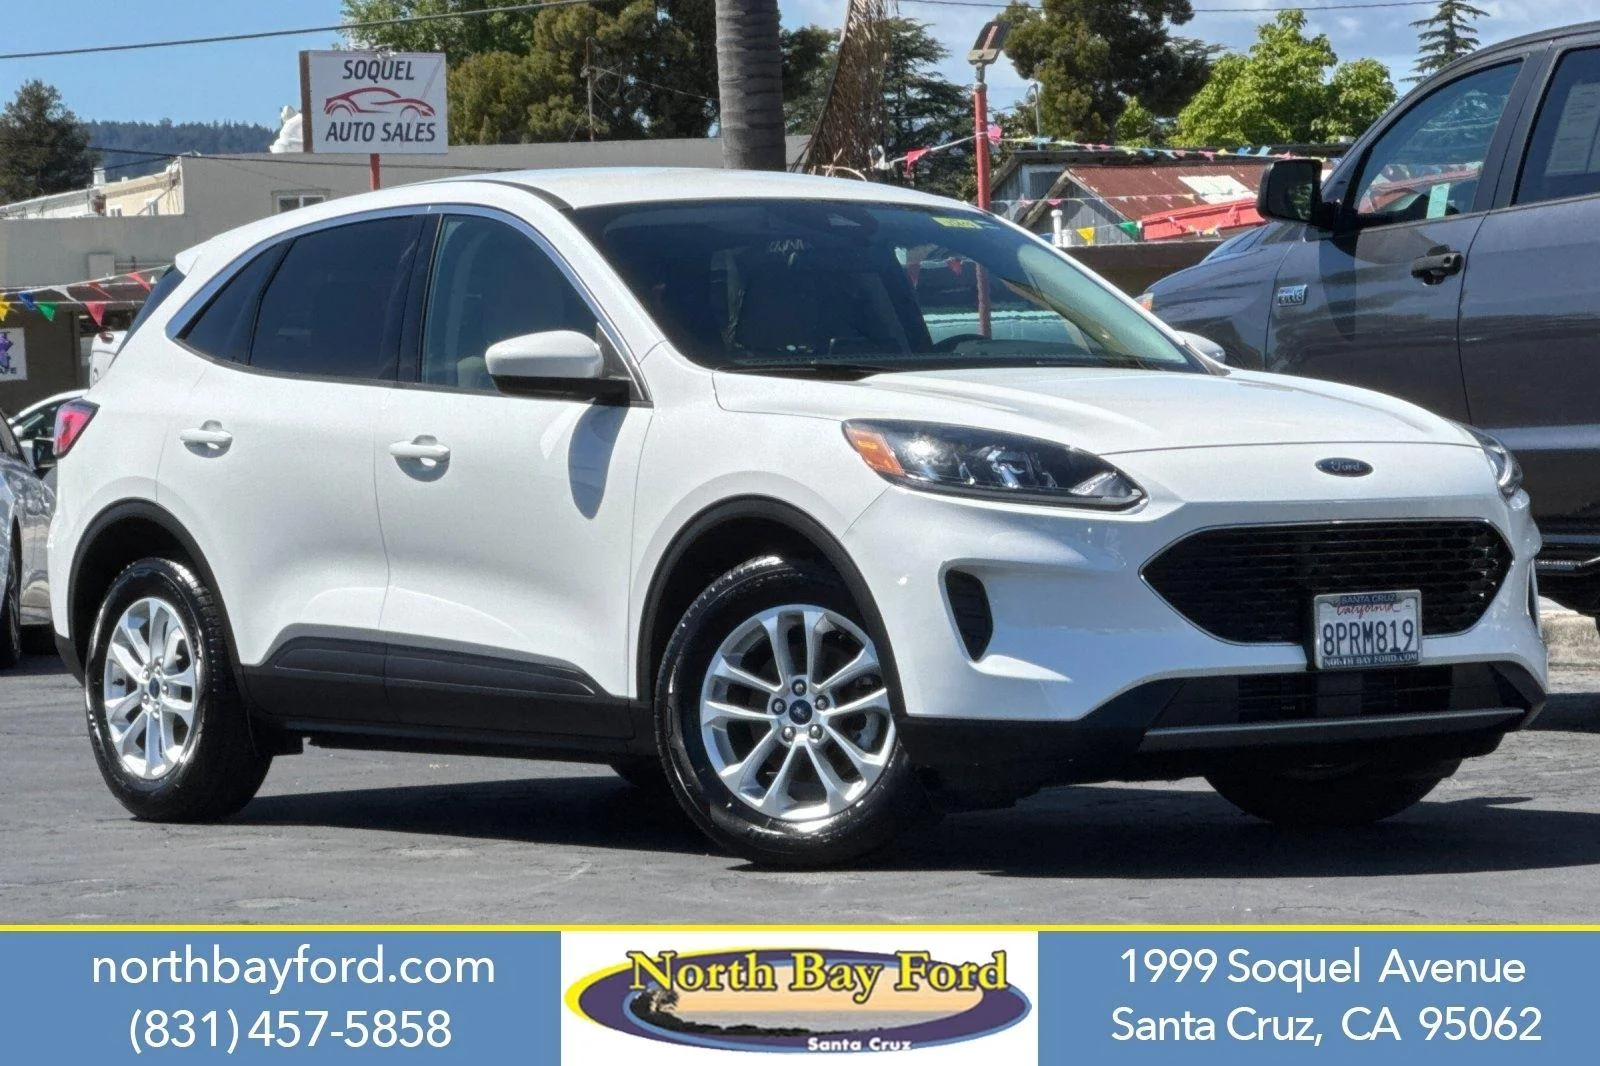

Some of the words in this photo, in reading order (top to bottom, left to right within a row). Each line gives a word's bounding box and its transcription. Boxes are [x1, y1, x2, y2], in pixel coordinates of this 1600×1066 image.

[342, 59, 415, 83] SOQUEL
[325, 121, 375, 142] AUTO
[380, 122, 436, 142] SALES
[1331, 461, 1363, 471] Ford
[1322, 619, 1414, 656] 8PRM819
